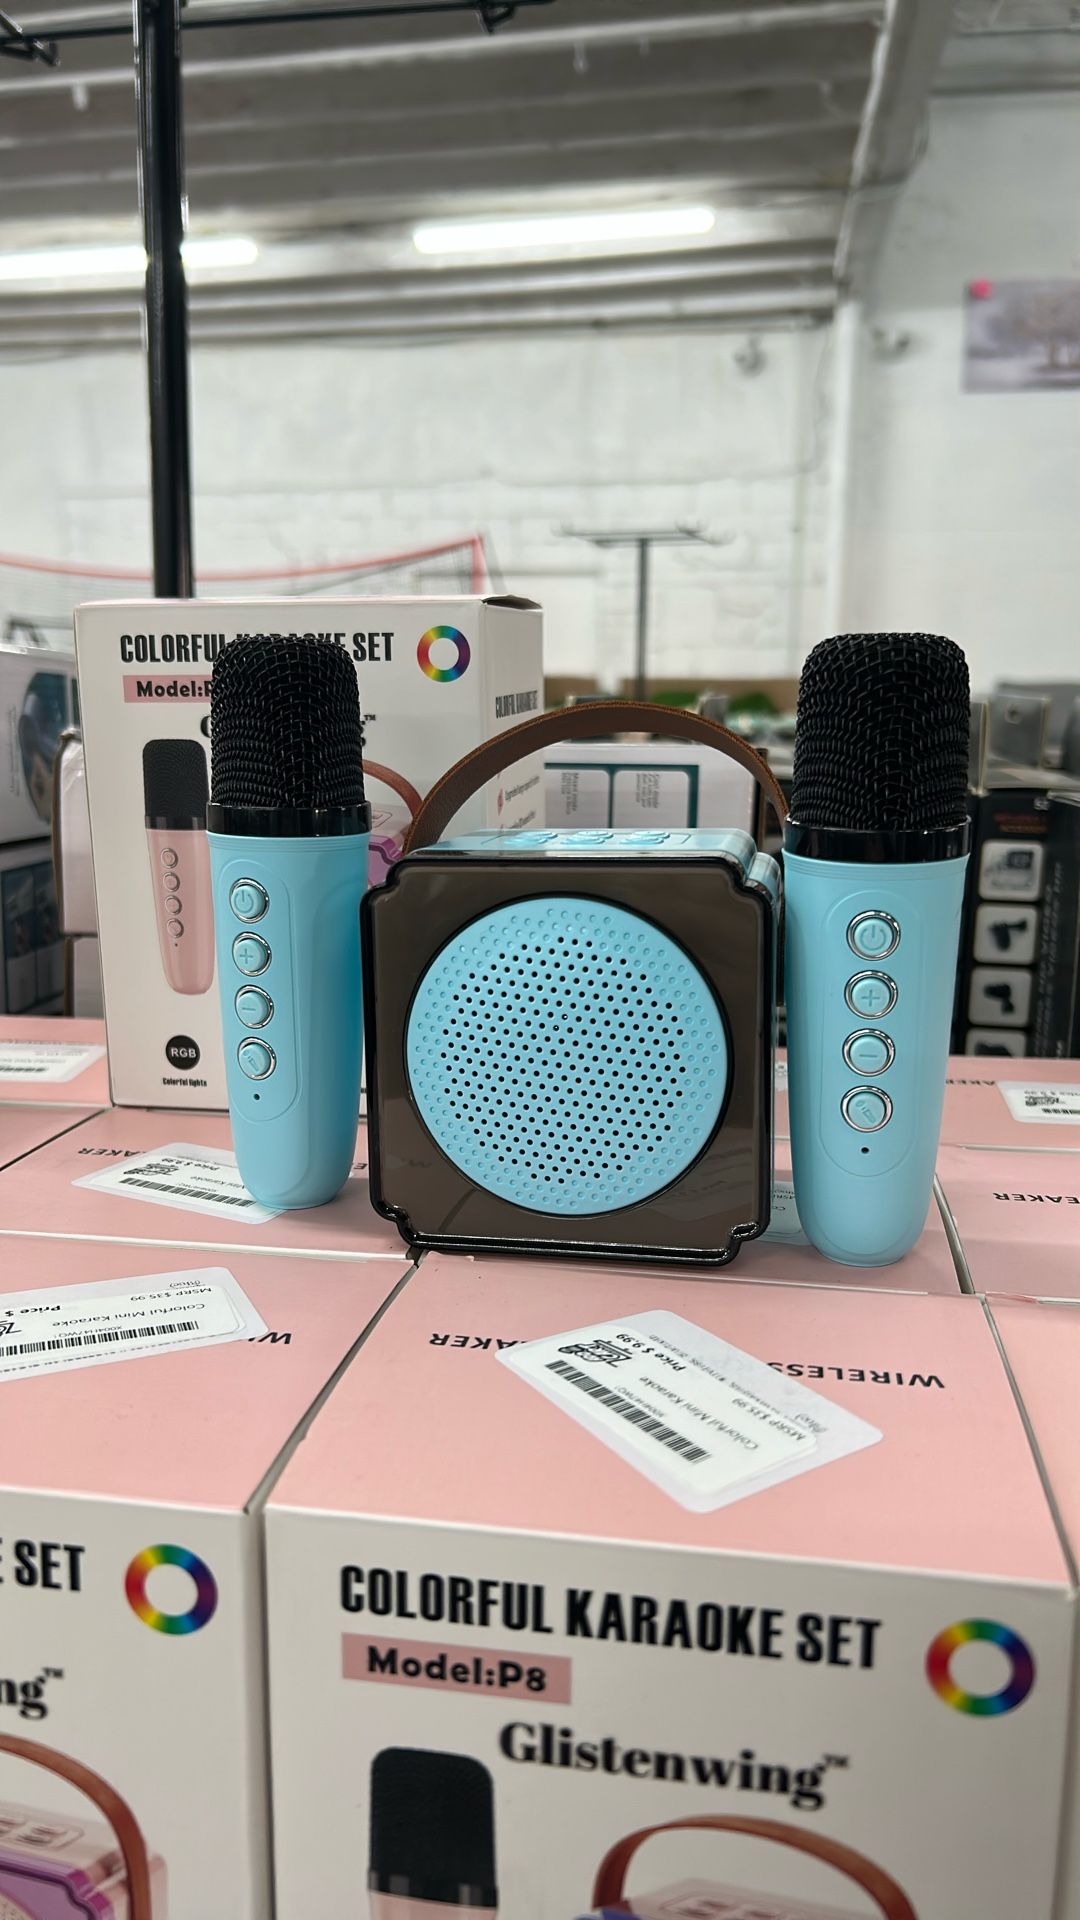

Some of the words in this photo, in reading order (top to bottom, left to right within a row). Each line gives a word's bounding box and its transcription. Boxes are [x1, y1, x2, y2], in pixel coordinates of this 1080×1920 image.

[352, 632, 394, 662] SET
[171, 1047, 197, 1059] RGB
[162, 1077, 188, 1086] Colorful
[189, 1078, 207, 1088] lights
[79, 1147, 149, 1157] AKER
[175, 1287, 212, 1296] MSRP
[20, 1305, 61, 1314] Price
[114, 1310, 145, 1320] Mini
[150, 1303, 205, 1316] Colorful
[52, 1315, 110, 1327] Karaoke
[429, 1333, 526, 1350] AKER
[616, 1333, 645, 1349] 9.99
[654, 1352, 687, 1372] Price
[639, 1376, 684, 1404] Karaoke
[681, 1401, 711, 1421] Mini
[707, 1418, 759, 1450] Colorful
[769, 1418, 806, 1441] MSRP
[14, 1539, 86, 1592] SET
[340, 1565, 553, 1634] COLORFUL
[566, 1588, 785, 1660] KARAOKE
[796, 1612, 882, 1669] SET
[366, 1645, 547, 1693] Model:P8
